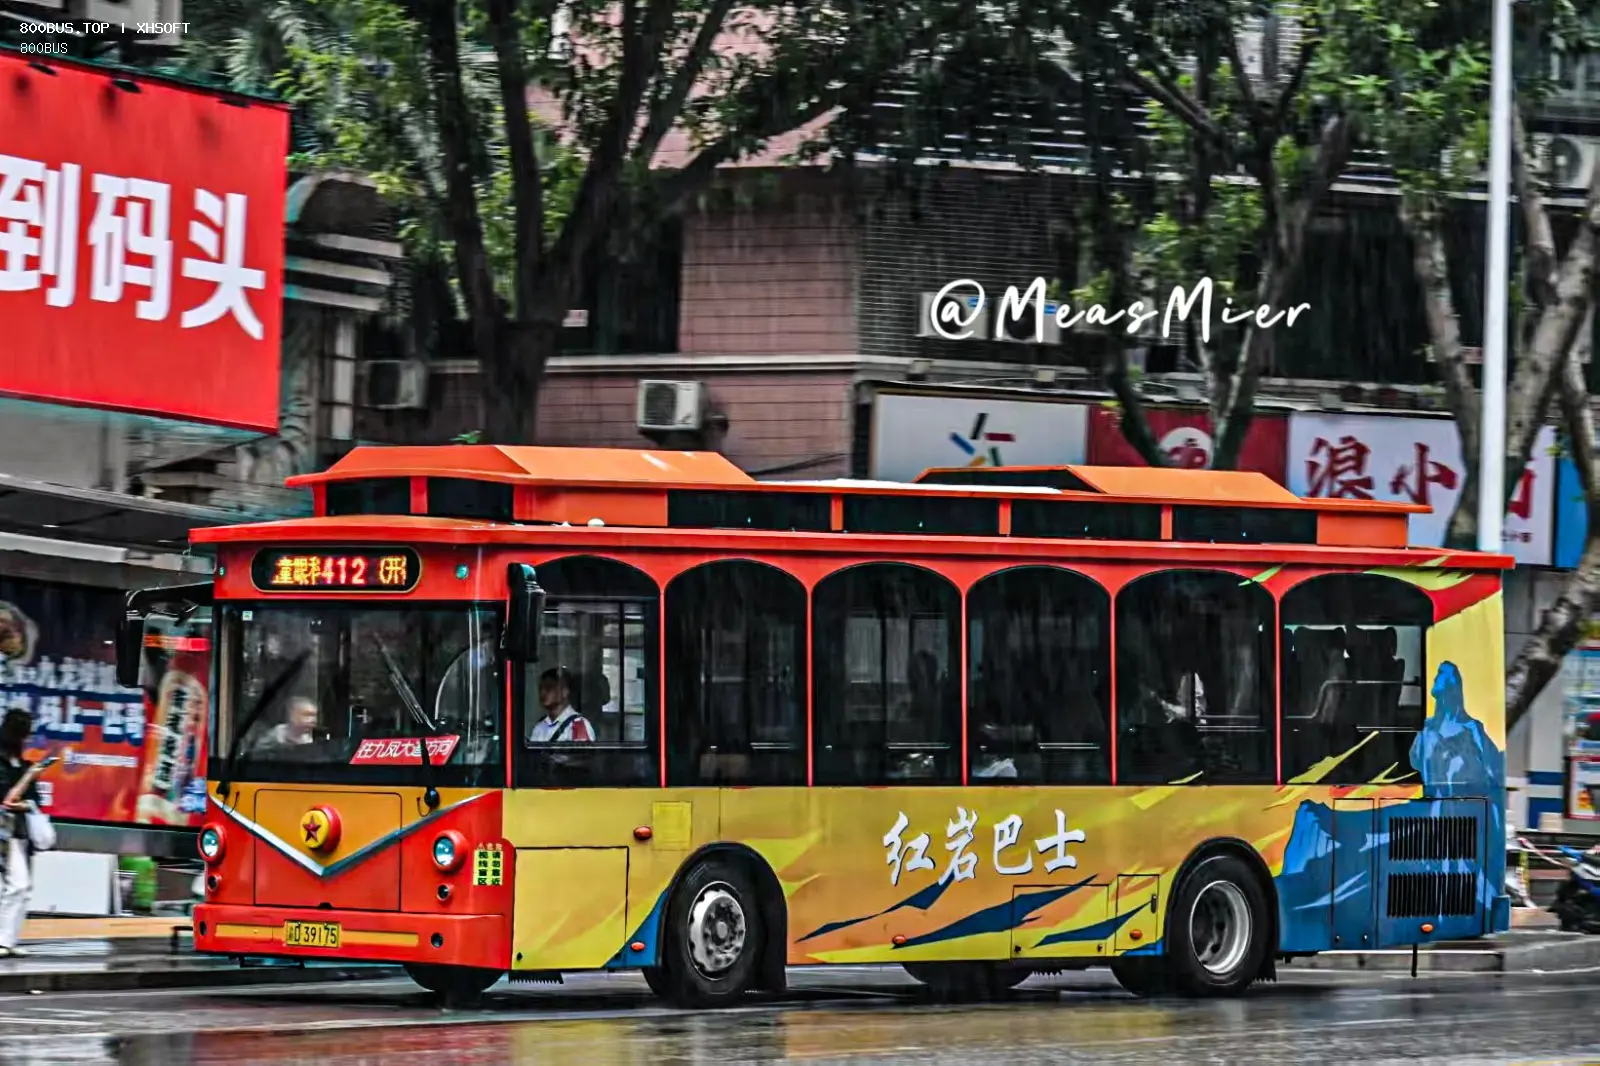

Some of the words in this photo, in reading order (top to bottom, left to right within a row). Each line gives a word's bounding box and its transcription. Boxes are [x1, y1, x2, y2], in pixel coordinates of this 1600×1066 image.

[0, 154, 266, 341] 到码头
[882, 805, 1087, 887] 红岩巴士
